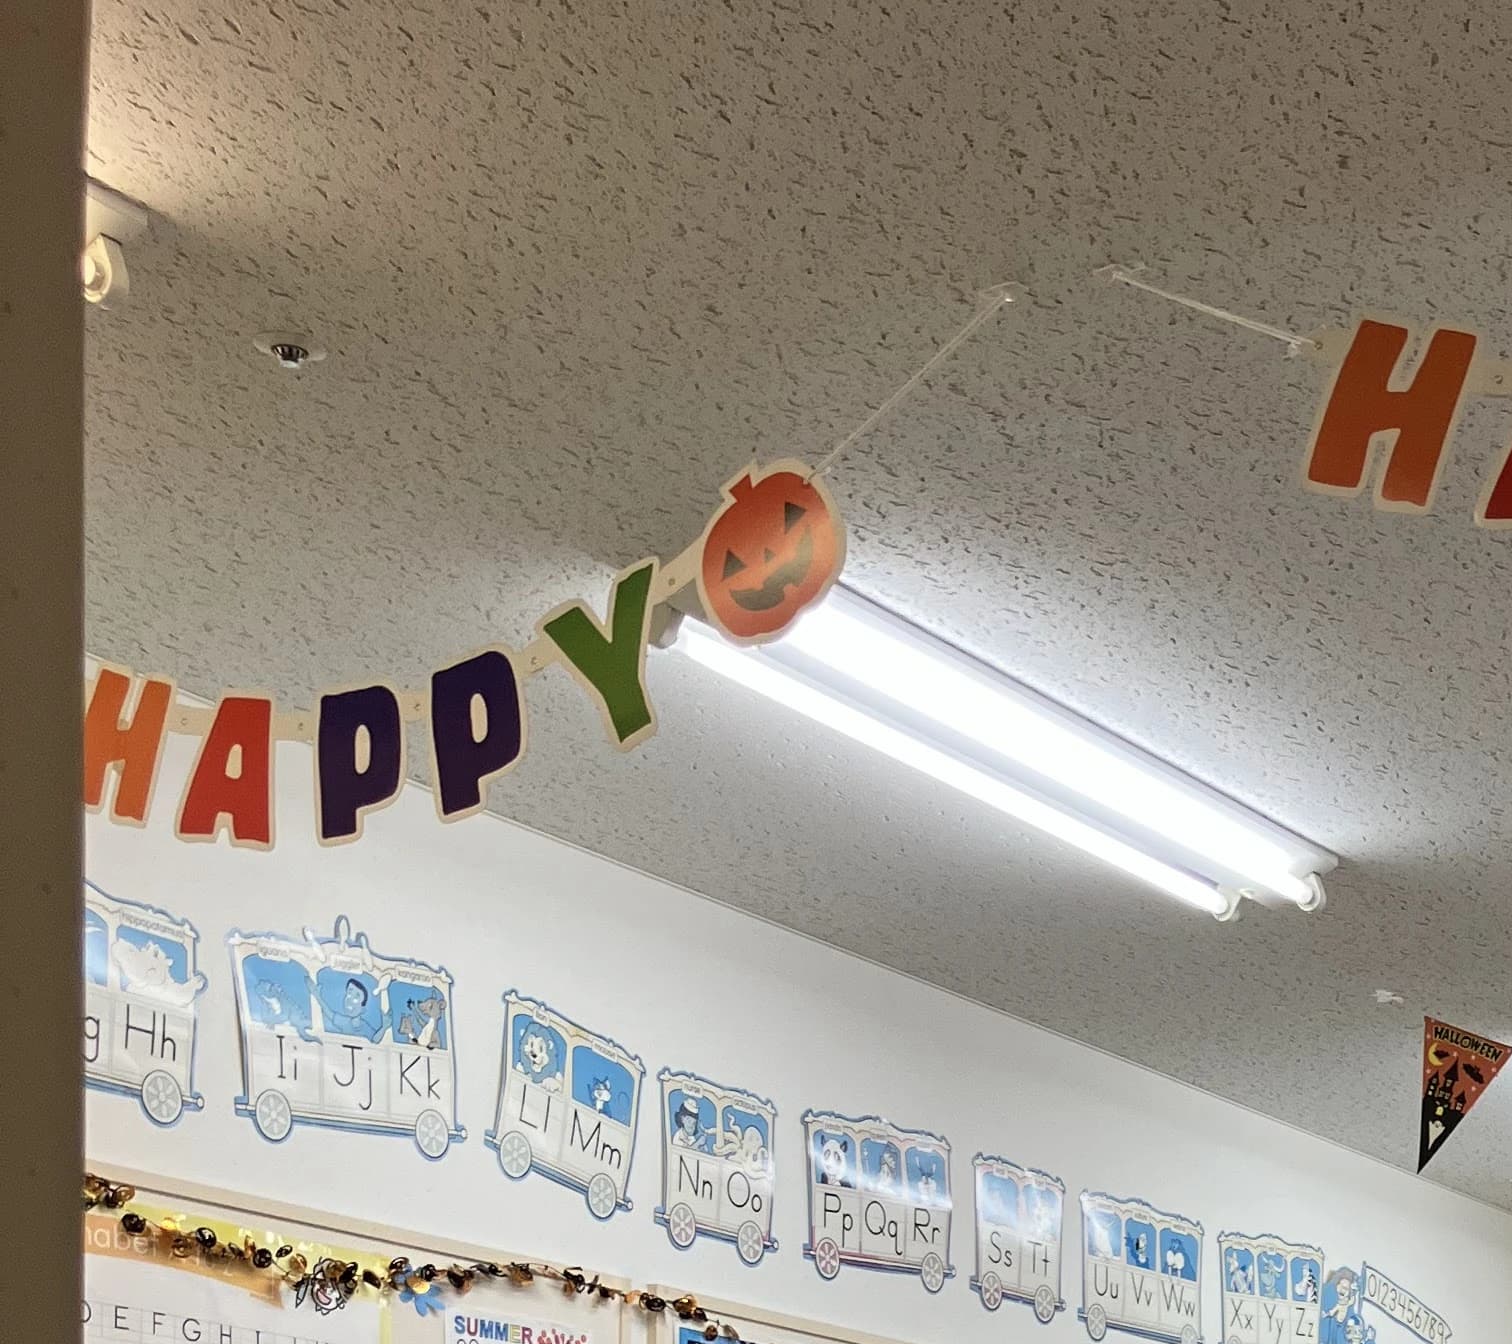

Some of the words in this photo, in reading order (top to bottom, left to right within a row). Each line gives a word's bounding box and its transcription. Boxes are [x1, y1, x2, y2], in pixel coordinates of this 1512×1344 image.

[84, 562, 652, 843] HAPPY
[125, 1003, 176, 1062] Hh
[1434, 1026, 1503, 1062] HALLOWEEN
[276, 1034, 297, 1081] Ii
[333, 1044, 372, 1110] Jj
[399, 1052, 441, 1100] Kk
[519, 1084, 551, 1133] Ll
[570, 1108, 622, 1170] Mm
[678, 1155, 713, 1201] Nn
[727, 1171, 762, 1213] Oo
[823, 1192, 853, 1248] Pp
[865, 1200, 902, 1256] Qq
[913, 1207, 941, 1244] Rr
[988, 1230, 1013, 1267] Ss
[1027, 1240, 1050, 1277] Tt
[1094, 1265, 1119, 1300] Uu
[1129, 1275, 1152, 1307] Vv
[1158, 1283, 1196, 1318] Ww
[1229, 1300, 1254, 1330] Xx
[1295, 1307, 1314, 1338] Zz
[114, 1305, 129, 1330] E
[152, 1311, 166, 1335] F
[182, 1318, 201, 1342] G
[453, 1315, 534, 1344] SUMMER
